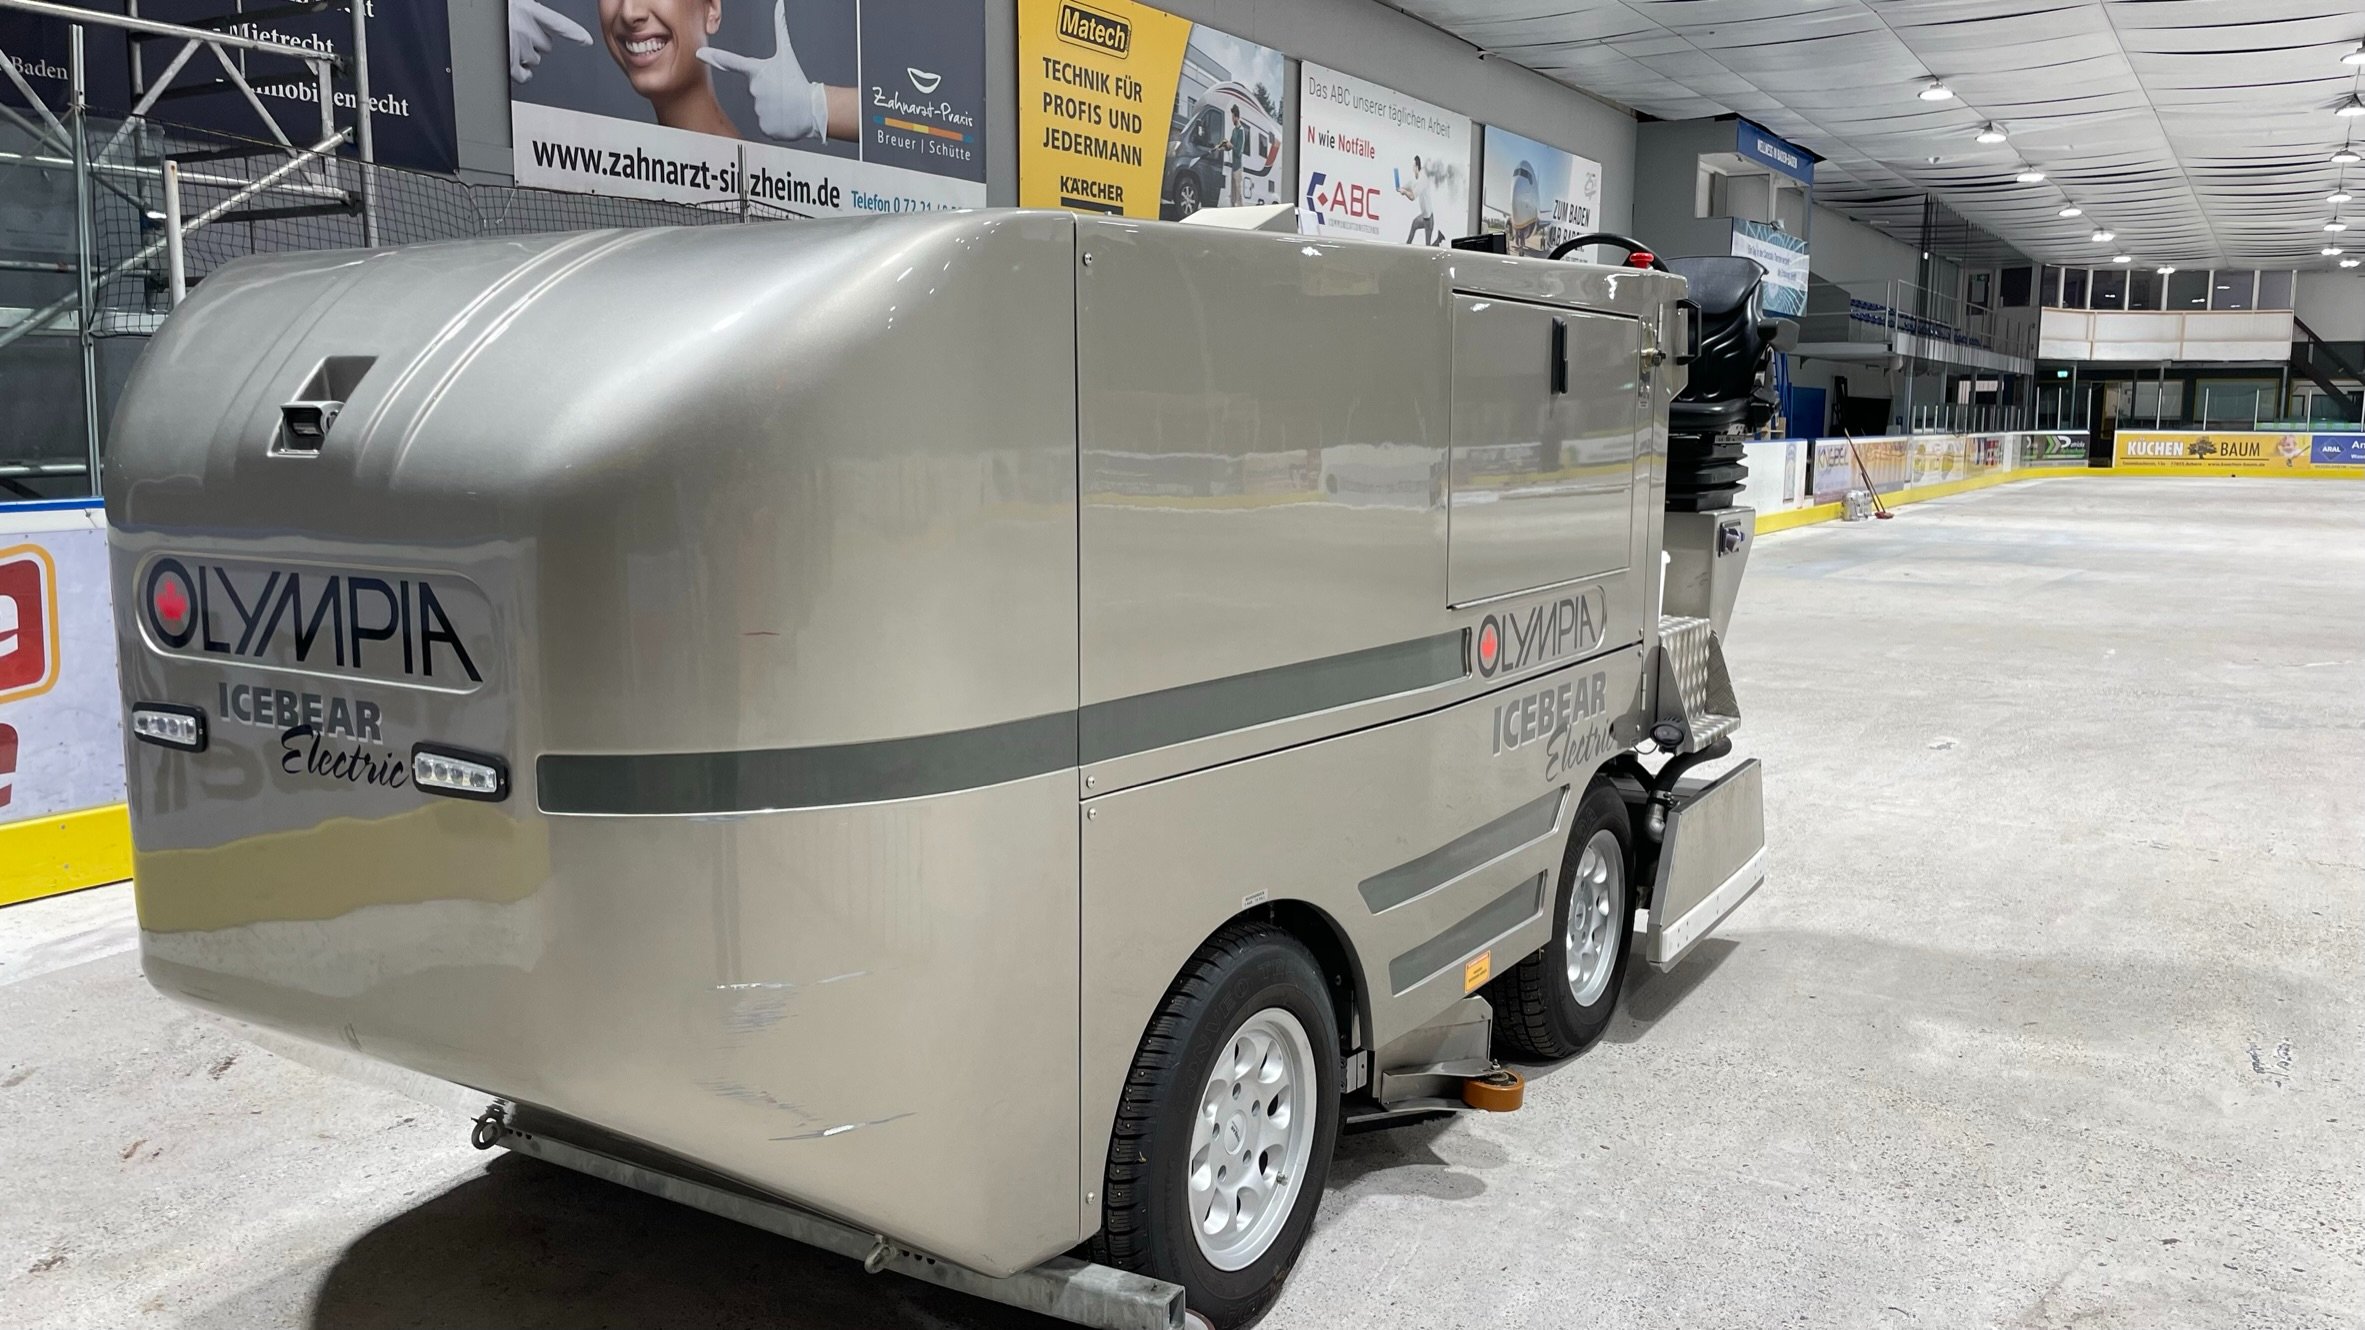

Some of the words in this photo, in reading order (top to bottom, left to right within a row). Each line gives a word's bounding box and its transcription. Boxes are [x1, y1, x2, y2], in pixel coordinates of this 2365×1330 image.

[1062, 8, 1126, 50] Matech
[1042, 56, 1111, 95] TECHNIK
[1115, 75, 1143, 103] FÜR
[872, 86, 973, 127] Zahnarzt-Praxis
[1043, 91, 1102, 126] PROFIS
[1109, 108, 1142, 134] UND
[1308, 76, 1328, 100] Das
[1330, 83, 1351, 106] ABC
[1352, 95, 1387, 117] unserer
[1388, 103, 1426, 131] täglichen
[1428, 116, 1451, 139] Arbeit
[877, 129, 917, 150] Breuer
[929, 140, 971, 161] Schütte
[1042, 126, 1142, 167] JEDERMANN
[1307, 125, 1316, 144] N
[1318, 130, 1336, 149] wie
[1338, 133, 1376, 159] Notfälle
[851, 189, 891, 213] Telefon
[1060, 175, 1124, 203] KÄRCHER
[1330, 181, 1381, 221] ABC
[1552, 199, 1569, 222] ZUM
[1568, 203, 1591, 228] BADEN
[2127, 438, 2184, 456] KÜCHEN
[2220, 442, 2261, 457] BAUM
[2321, 445, 2342, 453] ARAL
[146, 557, 484, 683] OLYMPIA
[1477, 594, 1597, 679] OLYMPIA
[217, 682, 384, 745] ICEBEAR
[1492, 671, 1607, 758] ICEBEAR
[280, 724, 410, 789] Electric
